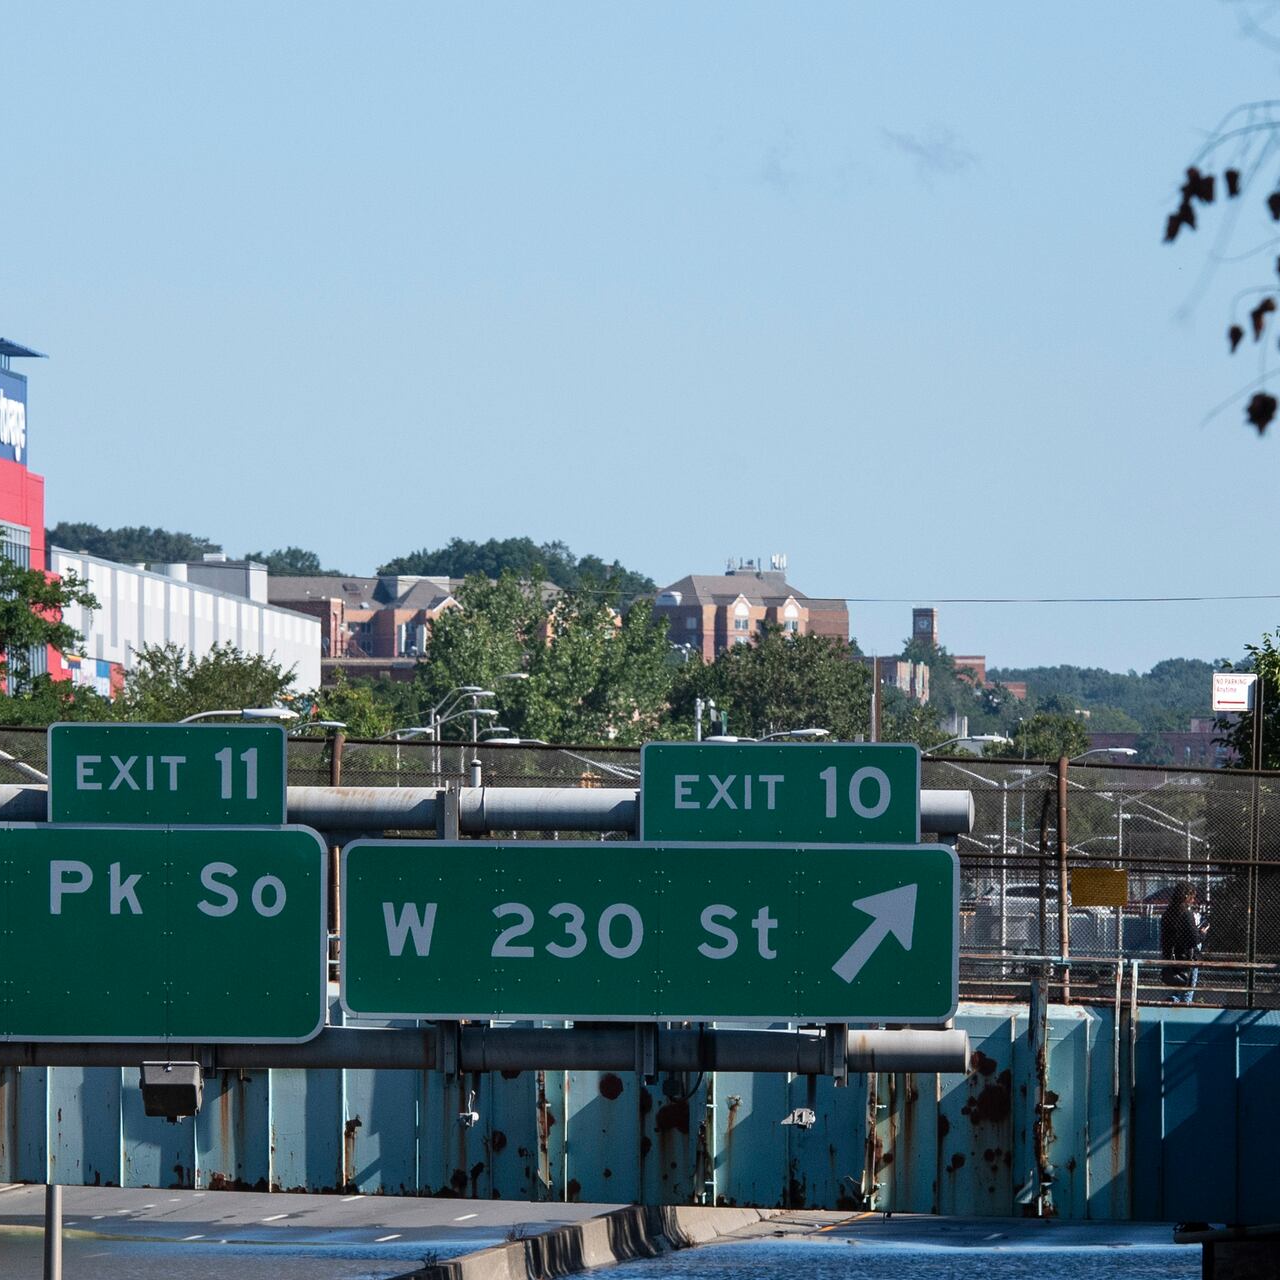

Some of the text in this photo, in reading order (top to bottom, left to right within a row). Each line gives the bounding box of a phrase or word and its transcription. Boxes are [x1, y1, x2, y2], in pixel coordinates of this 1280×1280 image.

[76, 747, 258, 799] EXIT 11
[674, 766, 891, 819] EXIT 10
[50, 860, 143, 915] Pk
[197, 861, 287, 917] So
[382, 902, 778, 960] W 230 St
